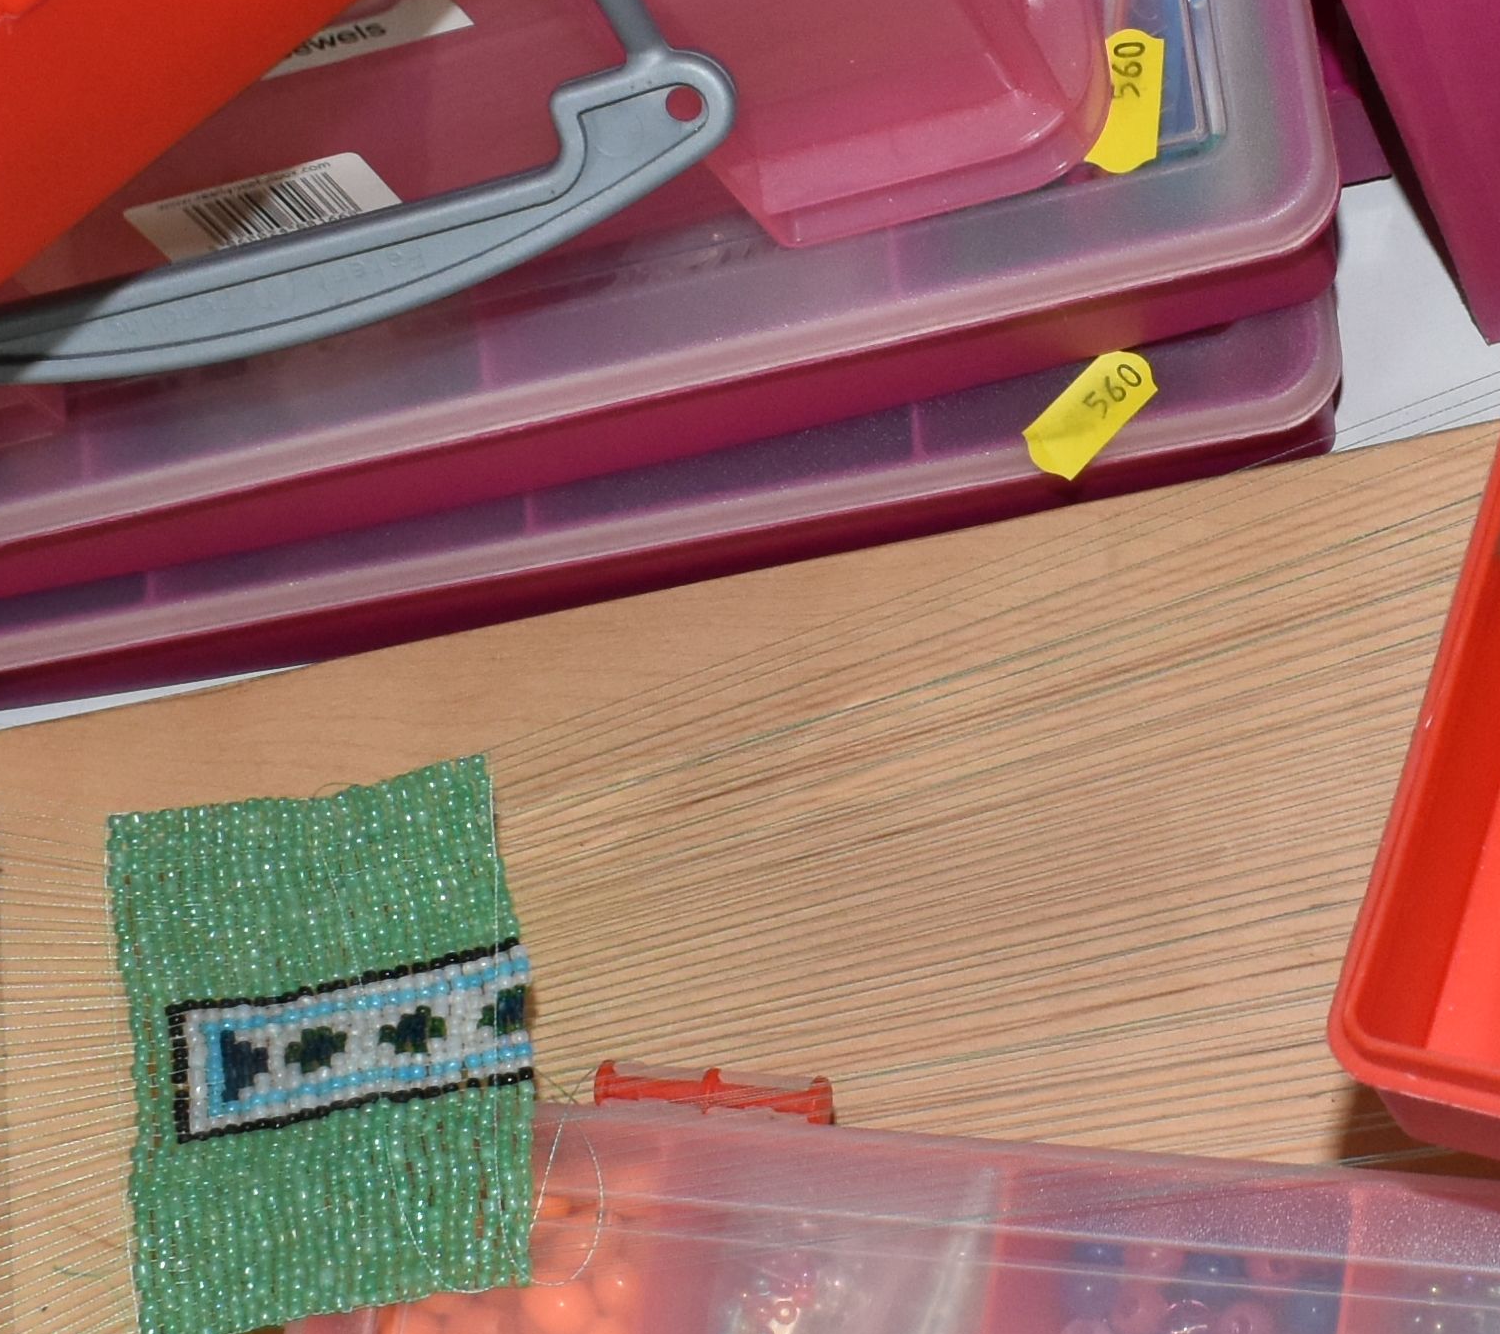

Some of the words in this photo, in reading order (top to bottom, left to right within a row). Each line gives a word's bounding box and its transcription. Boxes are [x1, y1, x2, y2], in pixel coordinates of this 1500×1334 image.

[285, 17, 387, 61] ewels
[1111, 40, 1146, 101] 560
[1082, 361, 1143, 419] 560
